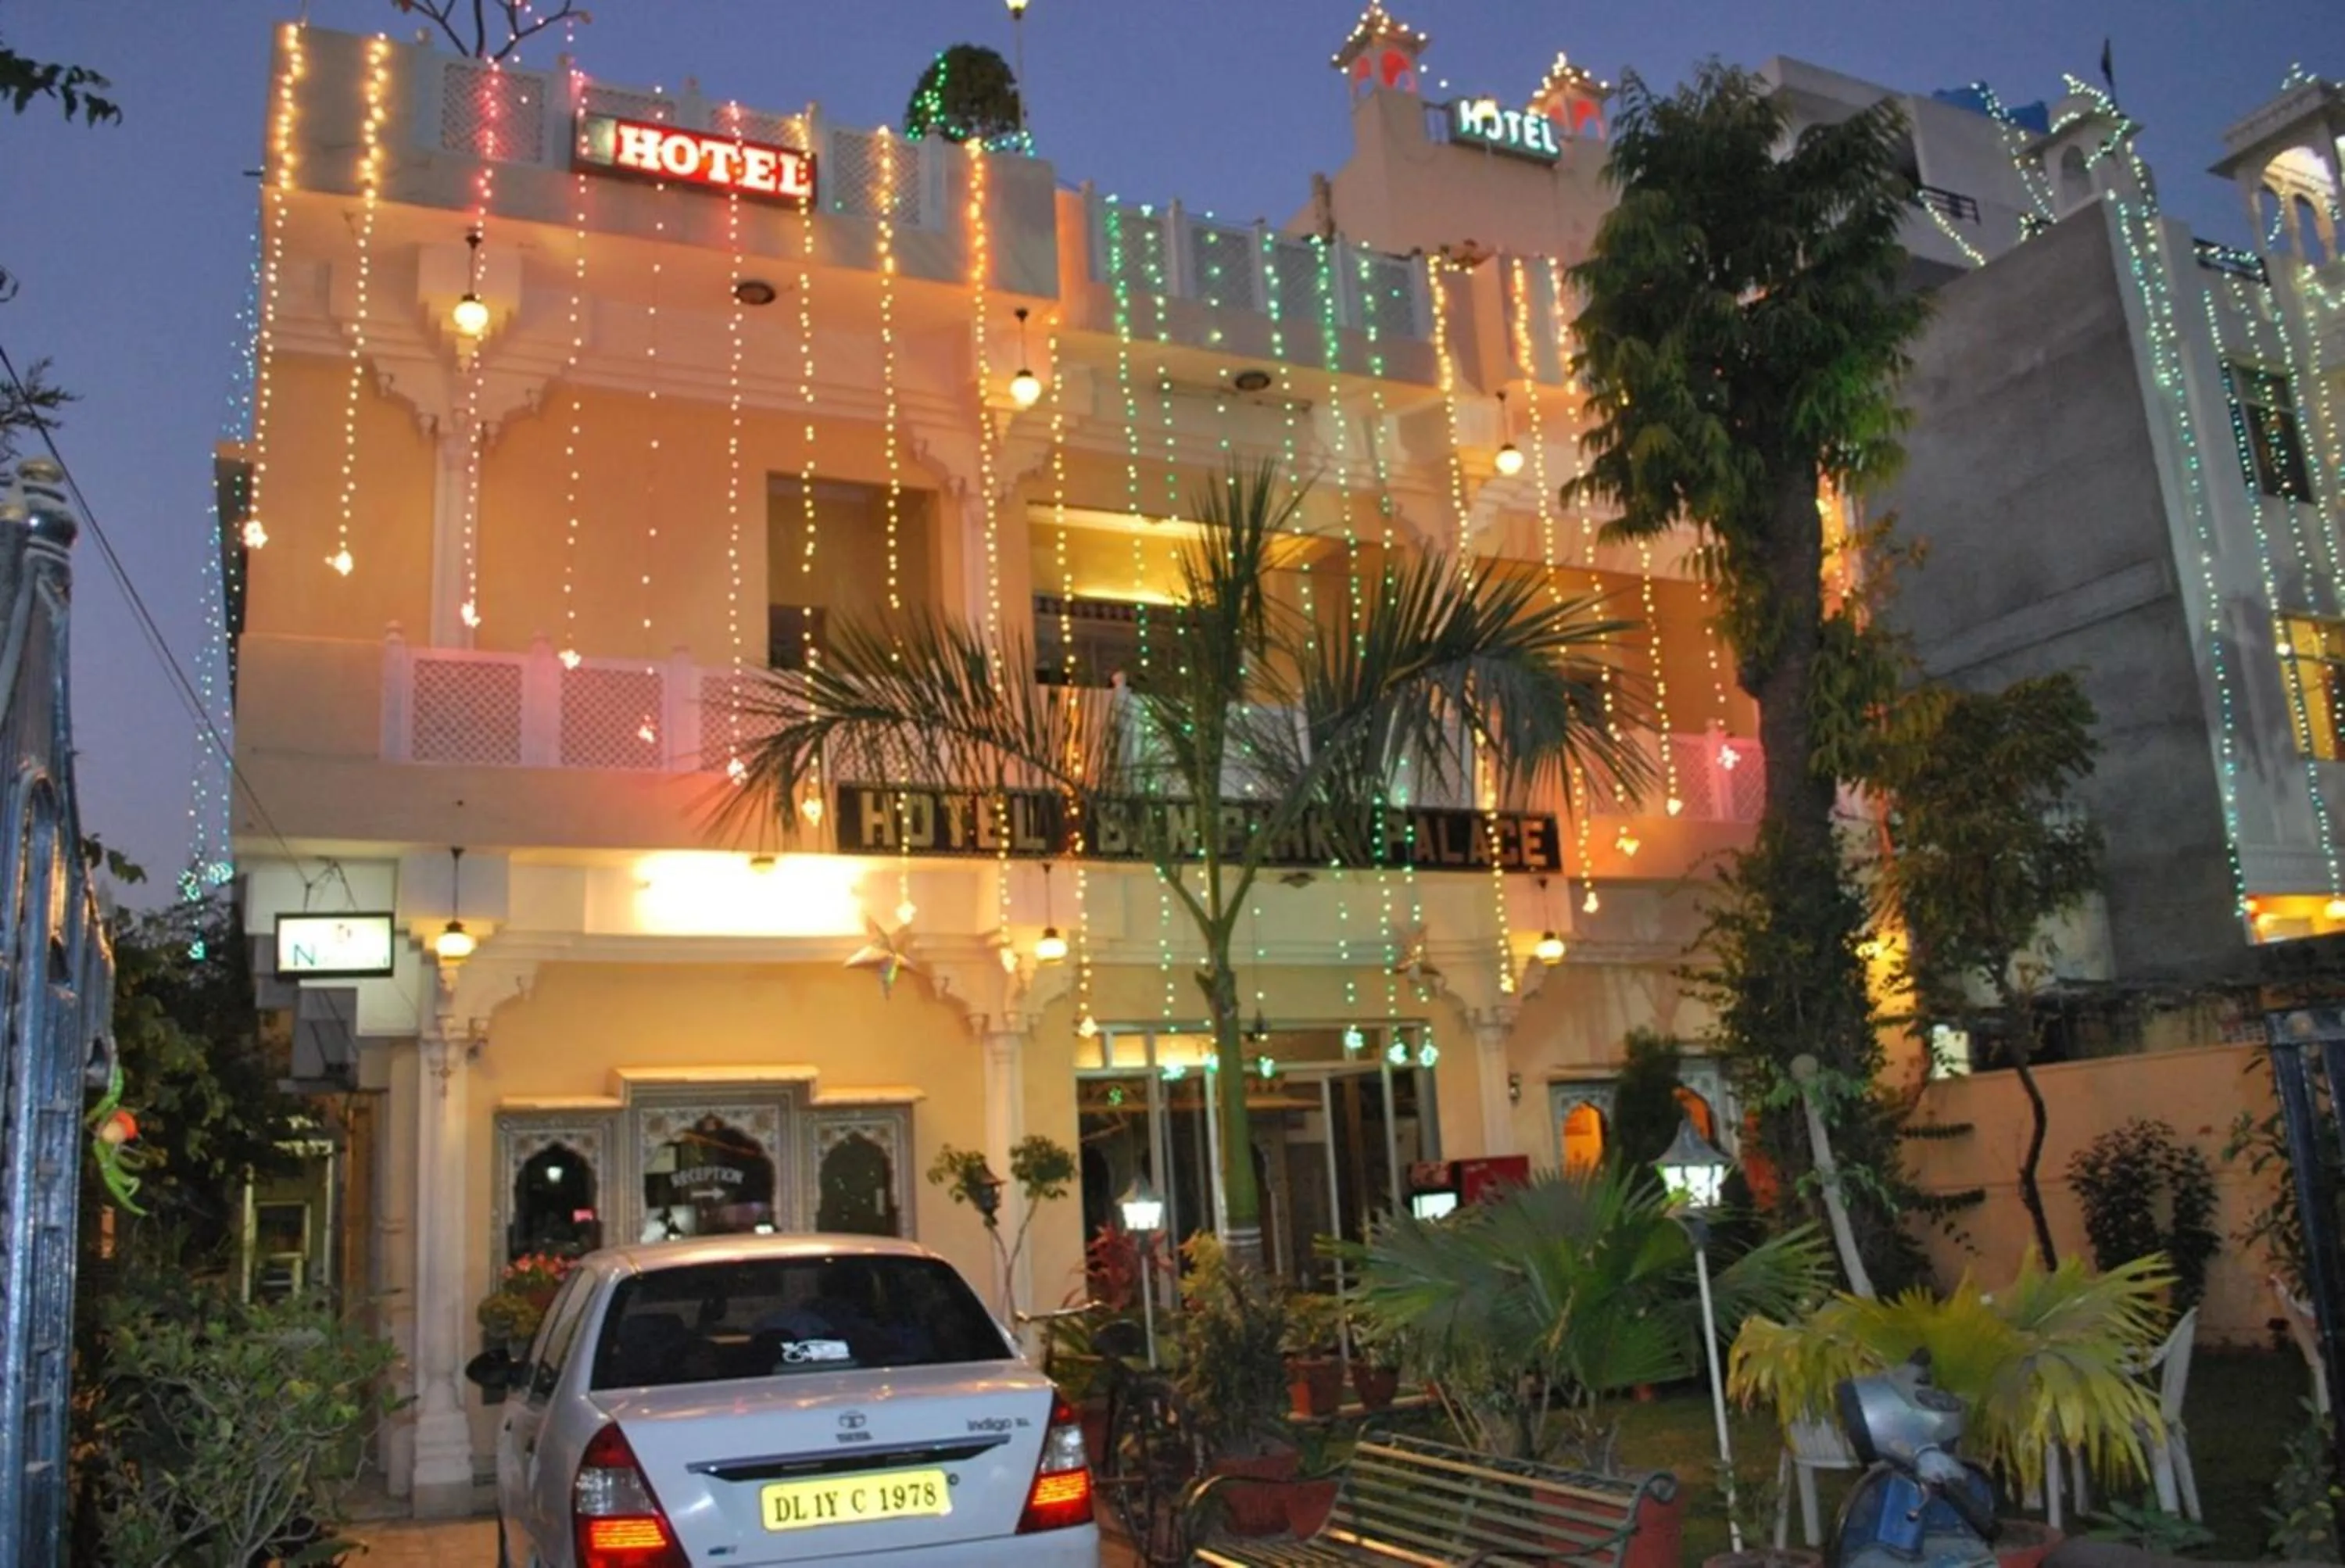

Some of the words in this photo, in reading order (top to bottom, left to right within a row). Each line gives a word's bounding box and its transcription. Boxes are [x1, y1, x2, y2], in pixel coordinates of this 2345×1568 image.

[1459, 99, 1558, 153] HOTEL
[617, 125, 811, 196] HOTEL
[861, 791, 1046, 849] HOTEL
[1384, 814, 1547, 866] PALACE
[670, 1165, 743, 1188] RECEPTION
[775, 1495, 808, 1523] DL
[851, 1488, 866, 1514] C
[879, 1482, 937, 1513] 1978
